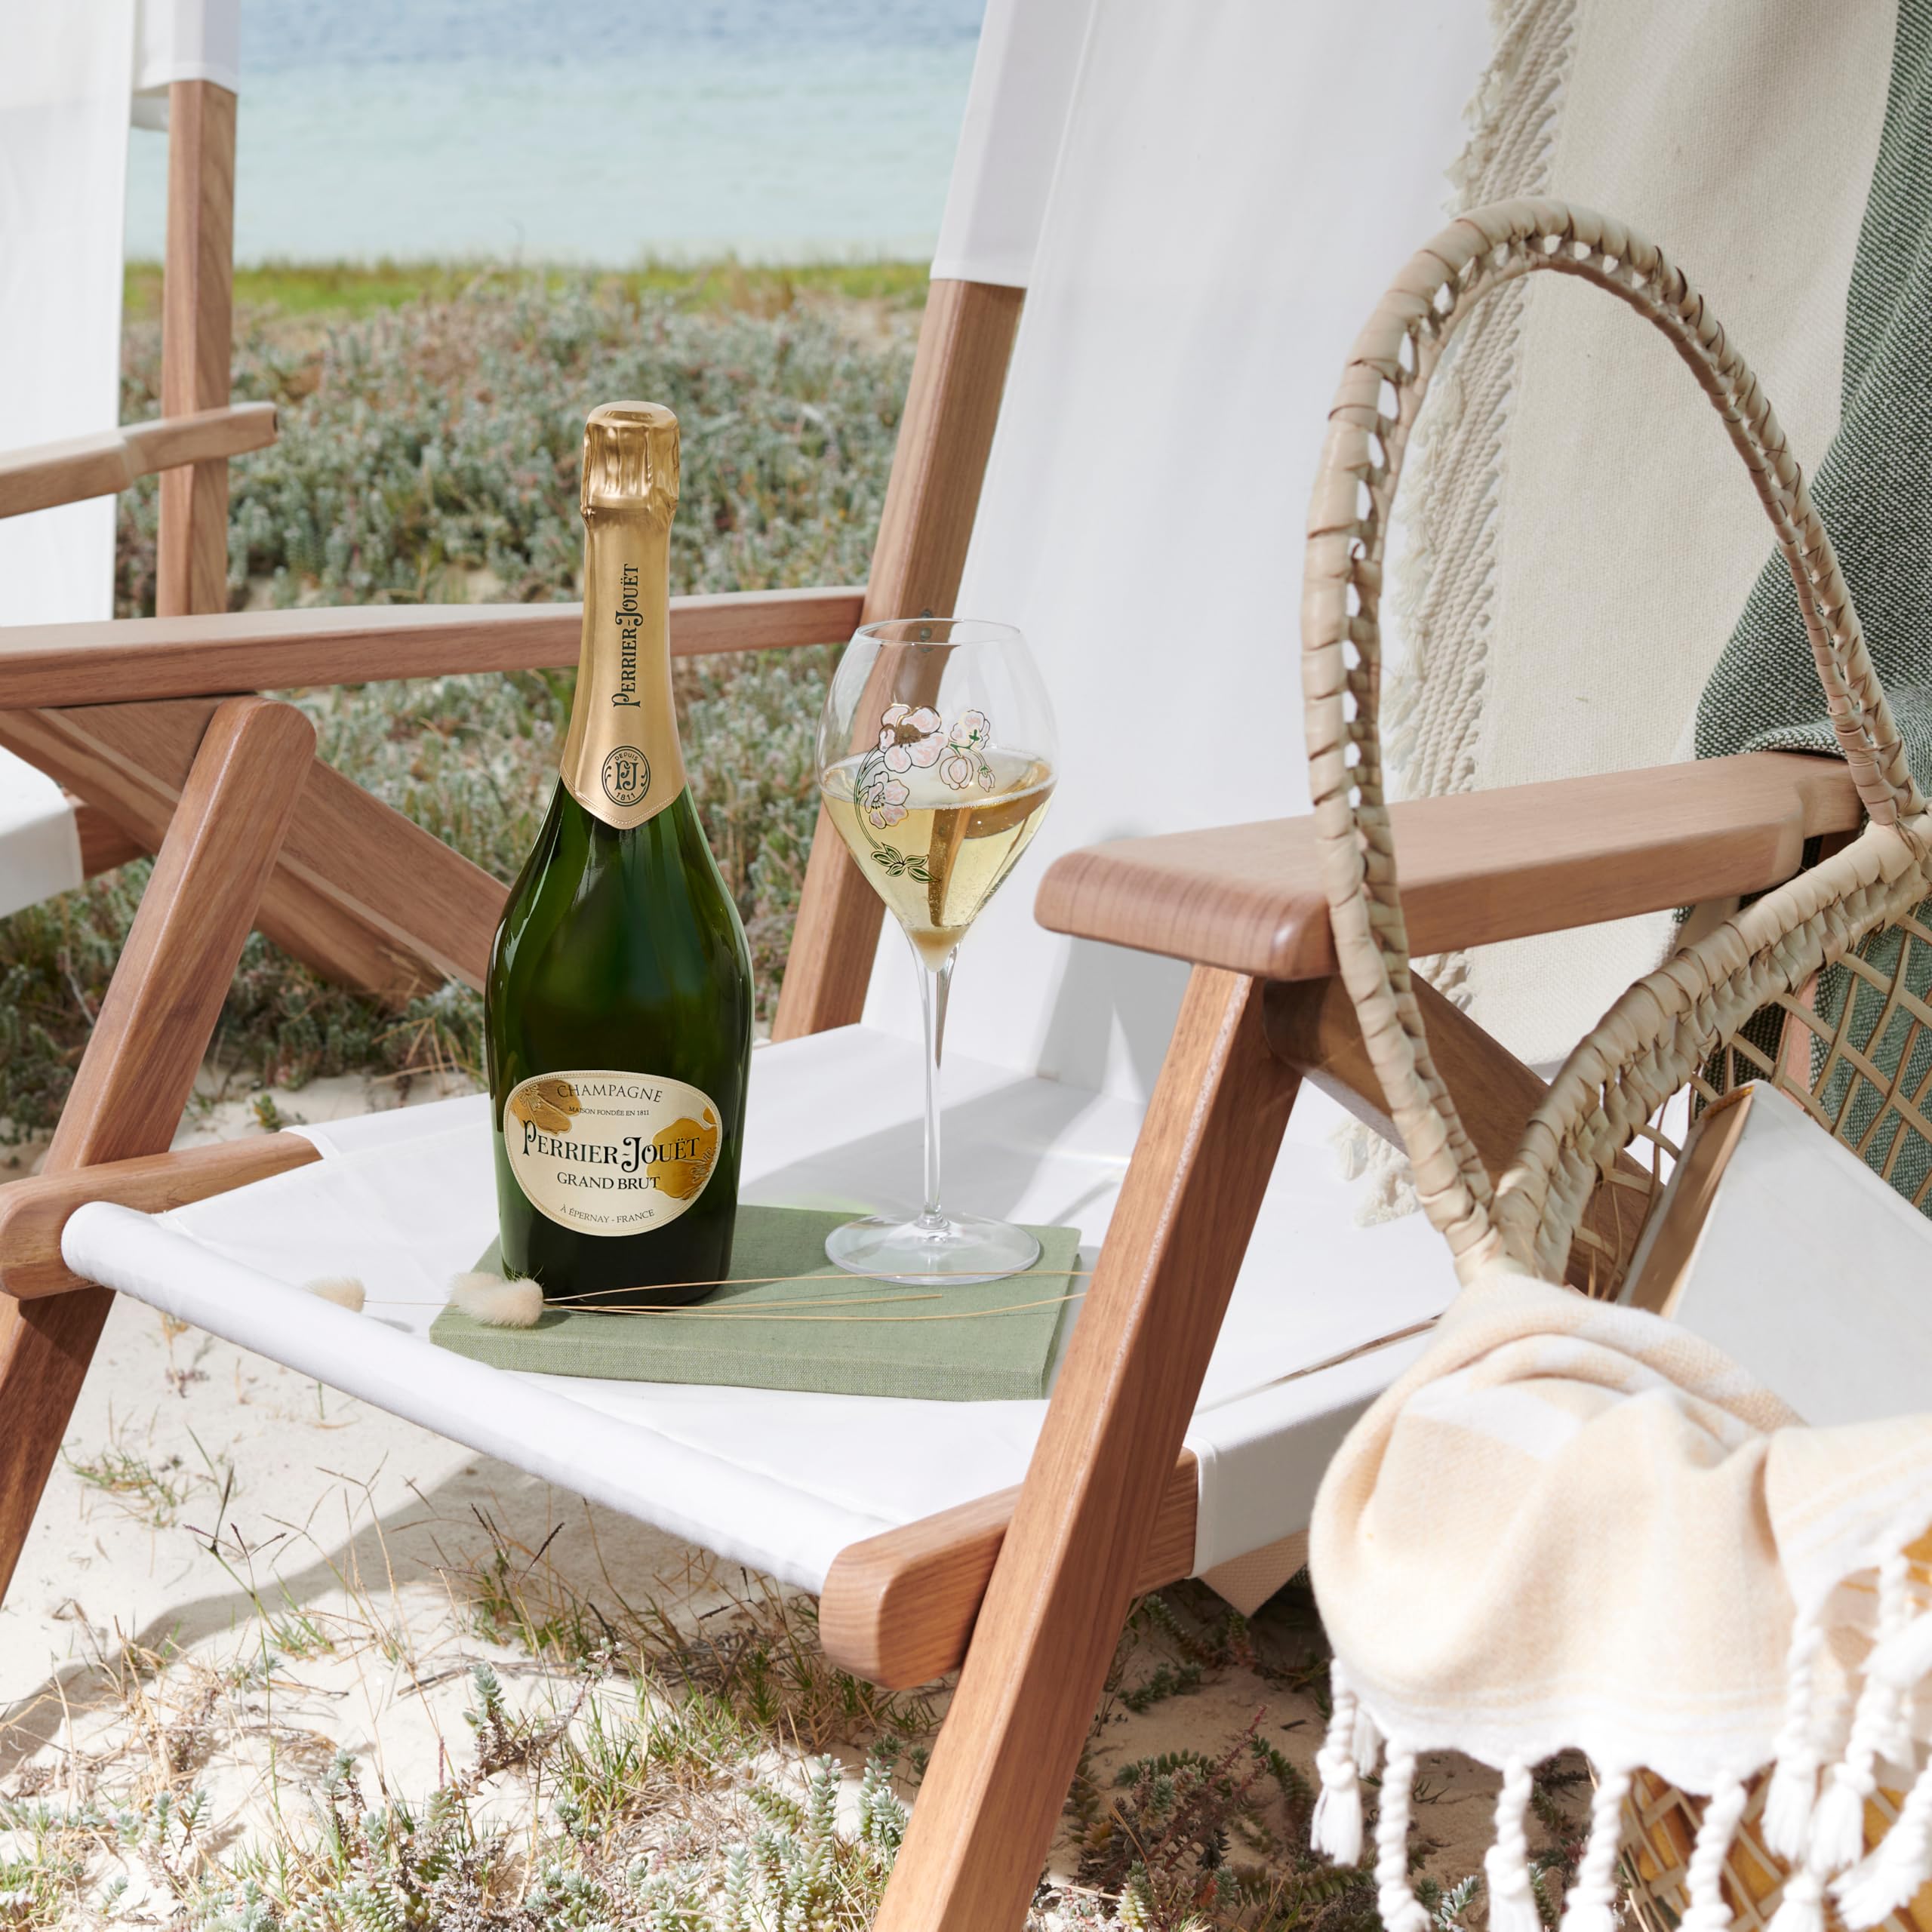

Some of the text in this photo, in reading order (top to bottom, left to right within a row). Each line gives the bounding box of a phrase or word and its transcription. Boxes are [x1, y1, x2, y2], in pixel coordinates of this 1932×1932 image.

[611, 563, 644, 708] PERRIER-JOUËT
[614, 752, 638, 761] DEPUIS
[616, 792, 636, 801] 1811
[557, 1084, 663, 1103] CHAMPAGNE
[568, 1106, 596, 1115] MAISON
[597, 1109, 625, 1117] FONDÉE
[522, 1120, 700, 1174] PERRIER-JOUËT
[557, 1171, 661, 1190] GRAND BRUT
[560, 1203, 567, 1214] À
[568, 1208, 610, 1223] ÉPERNAY
[617, 1209, 655, 1223] FRANCE
